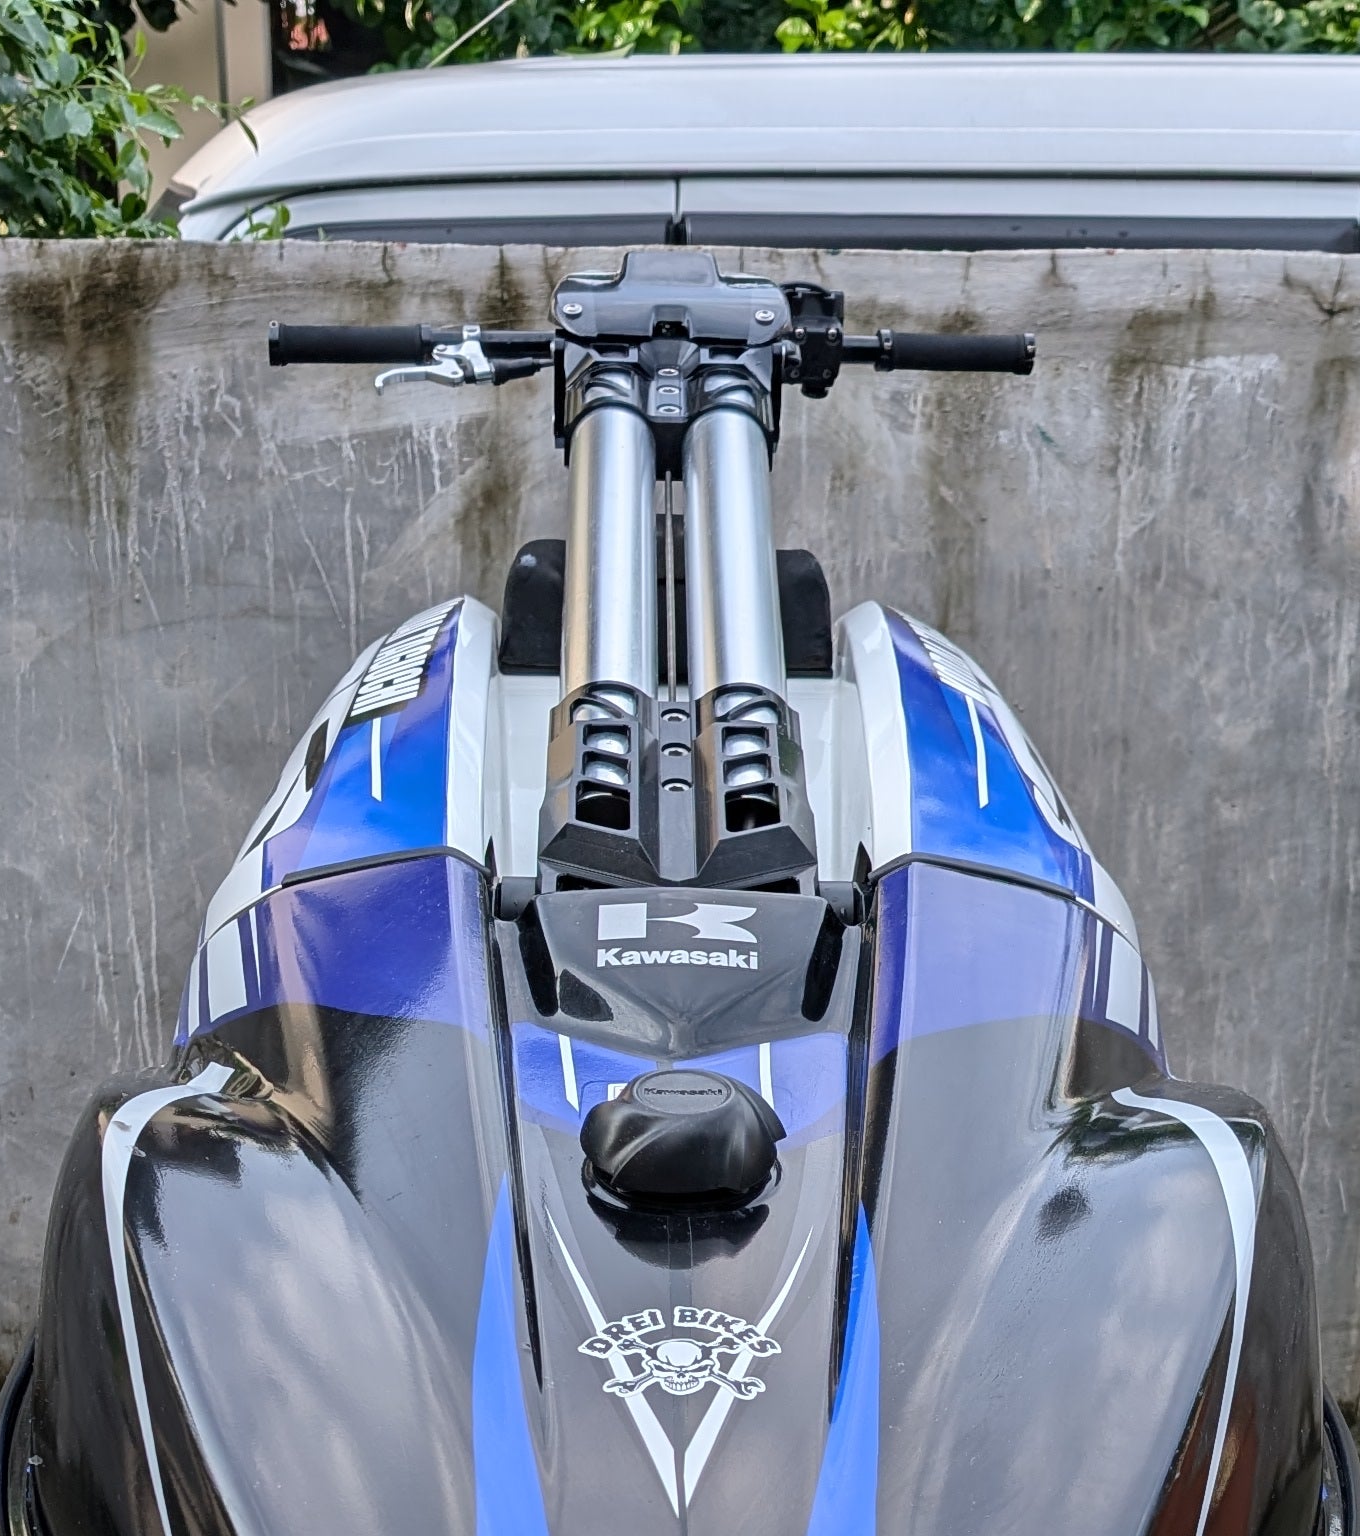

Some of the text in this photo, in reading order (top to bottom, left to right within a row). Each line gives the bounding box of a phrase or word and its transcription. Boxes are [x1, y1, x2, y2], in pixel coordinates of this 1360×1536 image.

[596, 948, 758, 969] Kawasaki
[582, 1307, 780, 1356] DREI BIKES
